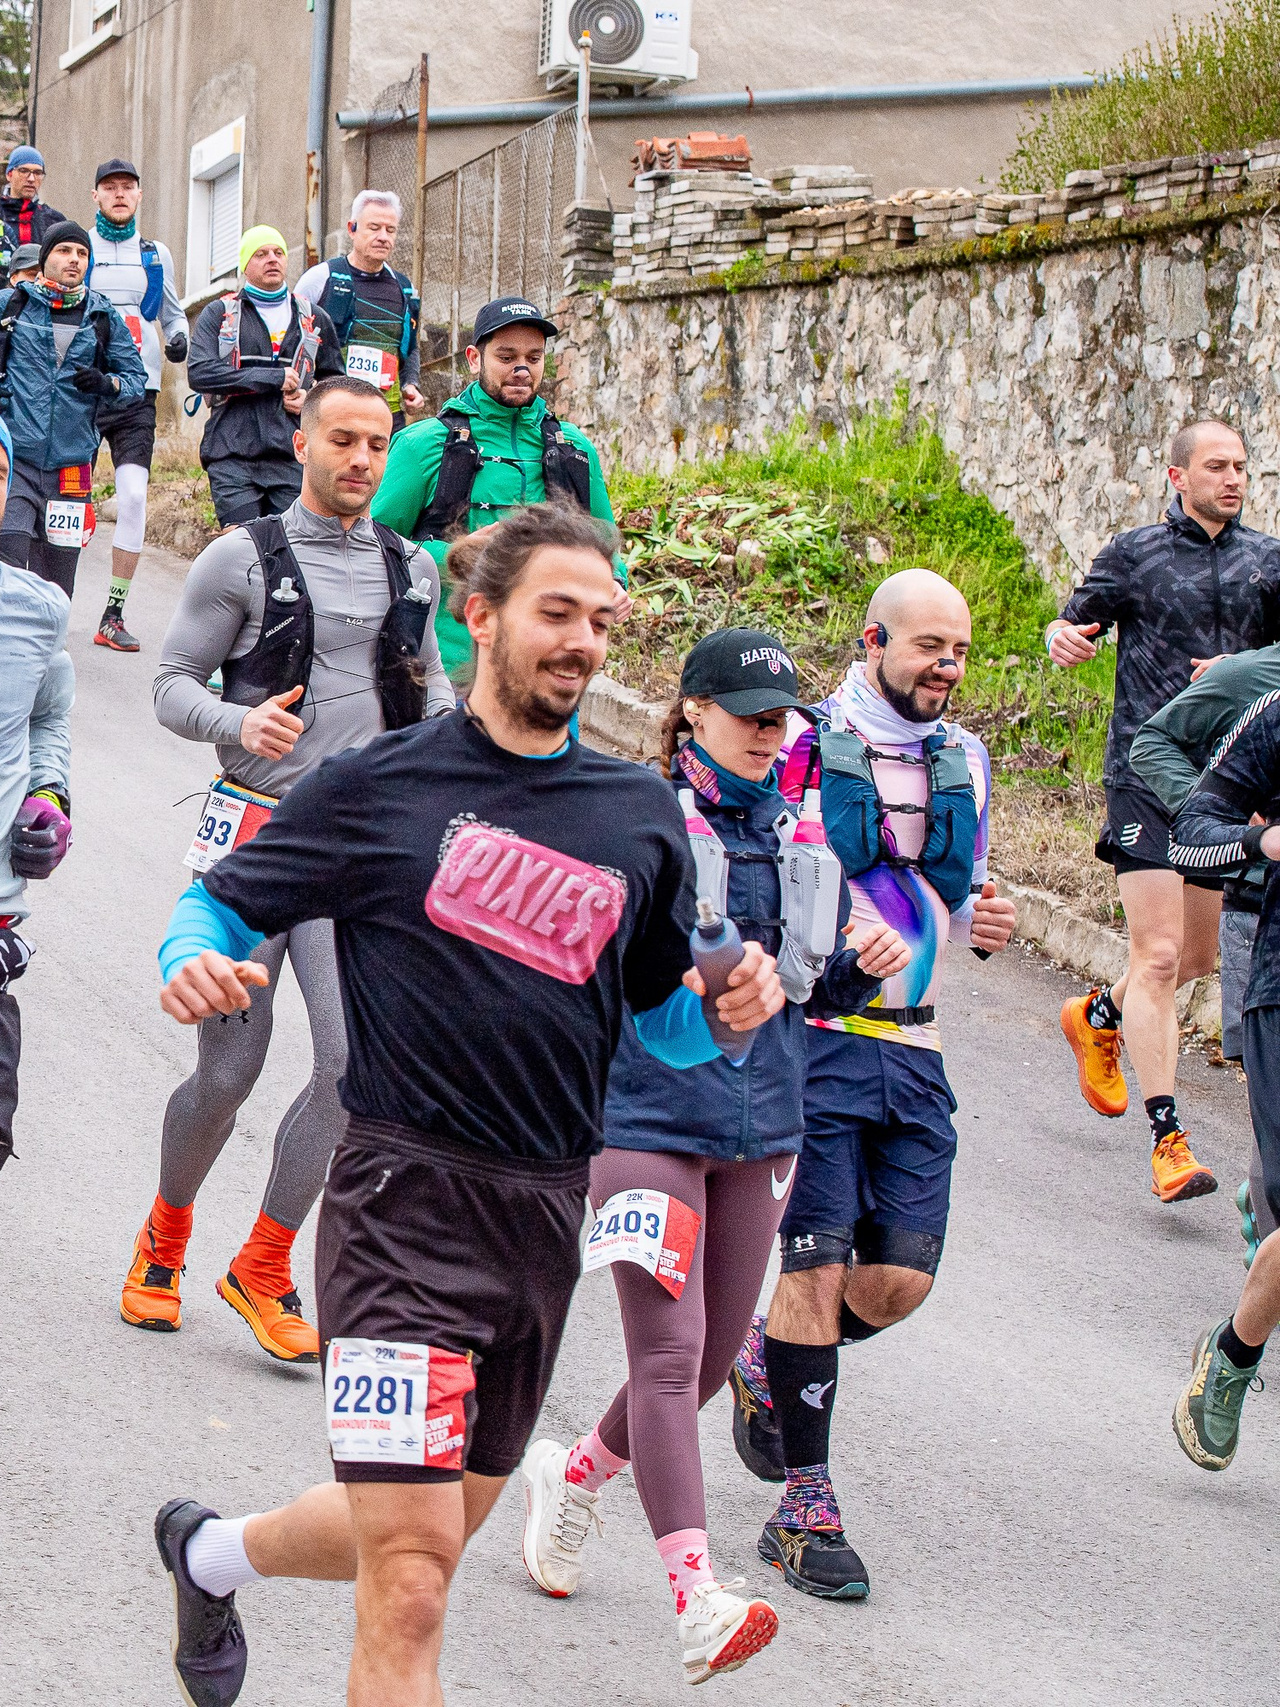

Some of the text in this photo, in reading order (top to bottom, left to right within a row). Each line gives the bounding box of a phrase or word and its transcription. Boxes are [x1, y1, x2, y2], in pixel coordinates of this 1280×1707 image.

[348, 356, 379, 373] 2336
[48, 514, 80, 530] 2214
[265, 616, 295, 638] SALOMON
[211, 796, 224, 808] 22K
[812, 856, 820, 890] KIPRUN
[444, 837, 611, 946] PIXIES
[626, 1192, 643, 1202] 22K
[588, 1210, 660, 1244] 2403
[376, 1348, 396, 1360] 22K
[333, 1375, 413, 1416] 2281
[331, 1419, 391, 1430] MARKOVO TRAIL
